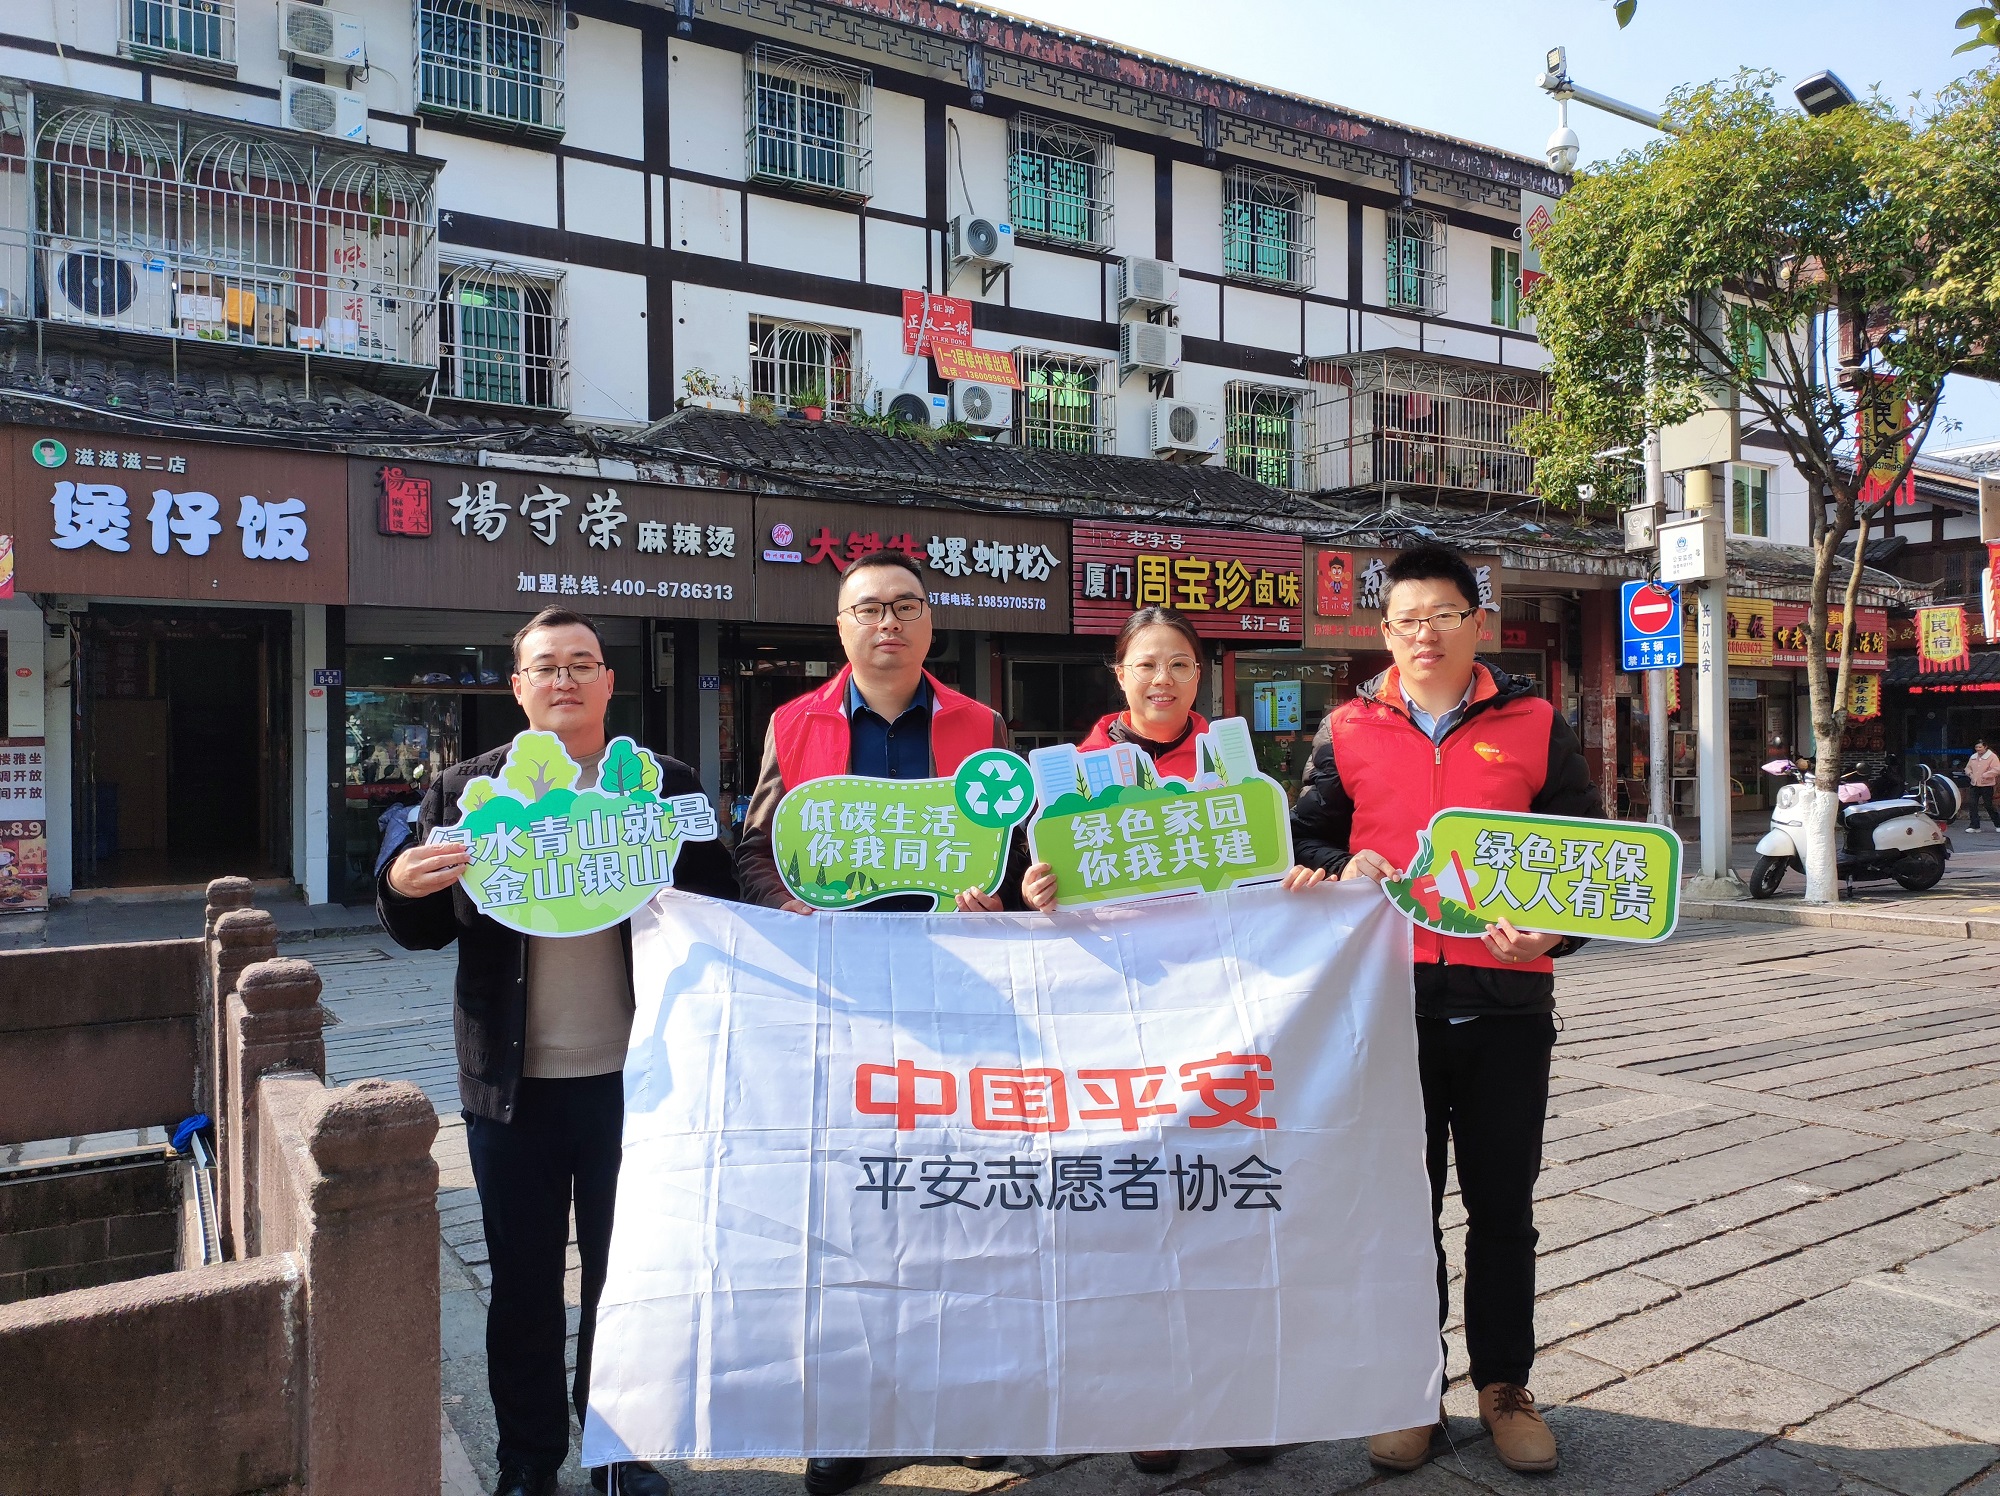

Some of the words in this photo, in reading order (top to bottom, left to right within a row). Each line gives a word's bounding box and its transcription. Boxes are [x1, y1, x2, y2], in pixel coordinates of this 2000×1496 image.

[906, 313, 970, 337] 正义二栋
[74, 447, 187, 474] 滋滋滋二店
[50, 480, 310, 562] 煲仔饭
[637, 520, 736, 559] 麻辣烫
[1240, 614, 1291, 633] 长汀一店
[1702, 604, 1711, 673] 长汀公安
[1930, 620, 1953, 649] 民宿
[1628, 652, 1678, 667] 禁止逆行
[1640, 641, 1664, 653] 车辆
[1854, 675, 1869, 715] 推拿按摩
[799, 798, 958, 837] 低碳生活
[1070, 793, 1248, 850] 绿色家园
[806, 833, 972, 873] 你我同行
[1077, 829, 1257, 888] 你我共建
[1473, 829, 1648, 882] 绿色环保
[481, 845, 671, 910] 金山银山
[1480, 870, 1655, 924] 人人有责
[855, 1050, 1278, 1132] 中国平安
[855, 1154, 1283, 1213] 平安志愿者协会
